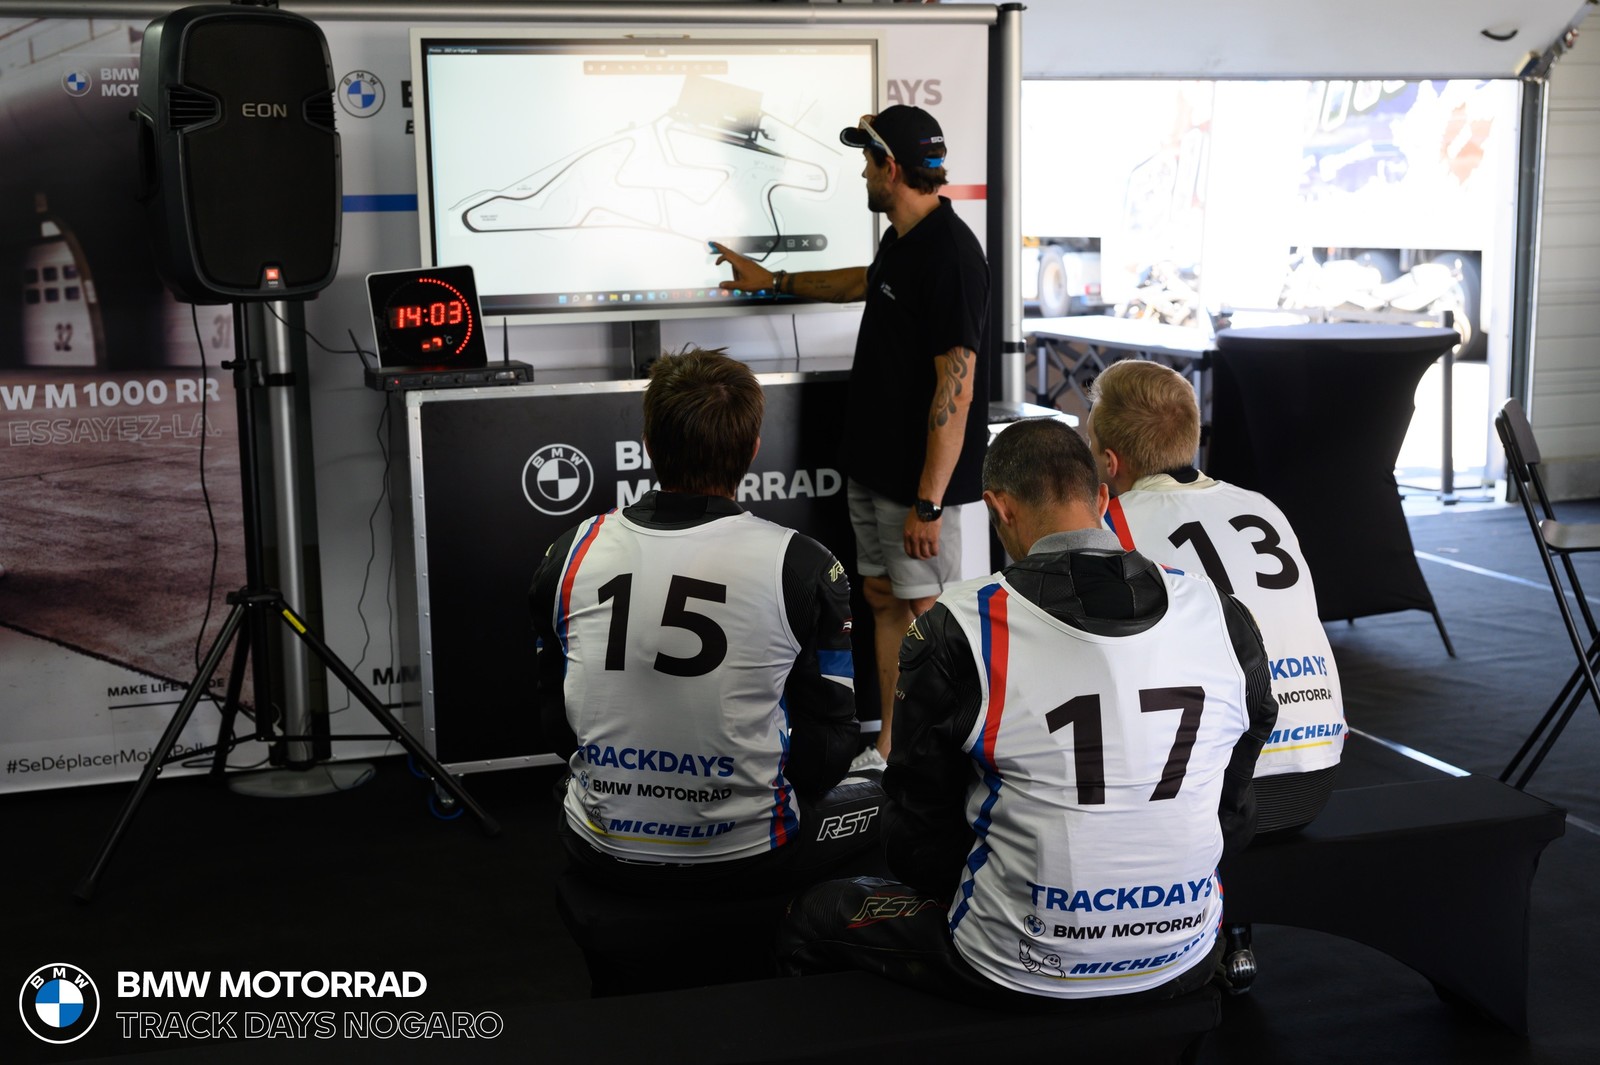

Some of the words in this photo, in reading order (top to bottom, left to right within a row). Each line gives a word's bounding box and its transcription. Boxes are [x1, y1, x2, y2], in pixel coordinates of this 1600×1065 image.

[242, 103, 288, 118] EON
[399, 301, 462, 328] 14:03
[0, 385, 36, 411] W
[45, 383, 77, 408] M
[83, 379, 168, 407] 1000
[175, 378, 221, 403] RR
[616, 468, 842, 508] MRRAD
[1167, 513, 1300, 595] 13
[597, 572, 728, 678] 15
[107, 684, 148, 697] MAKE
[1045, 685, 1205, 805] 17
[1266, 723, 1343, 744] MICHELIN
[593, 779, 632, 796] BMW
[637, 784, 732, 803] MOTORRAD
[609, 819, 736, 839] MICHELIN
[816, 806, 879, 842] RST
[1026, 872, 1214, 913] TRACKDAYS
[1053, 924, 1106, 940] BMW
